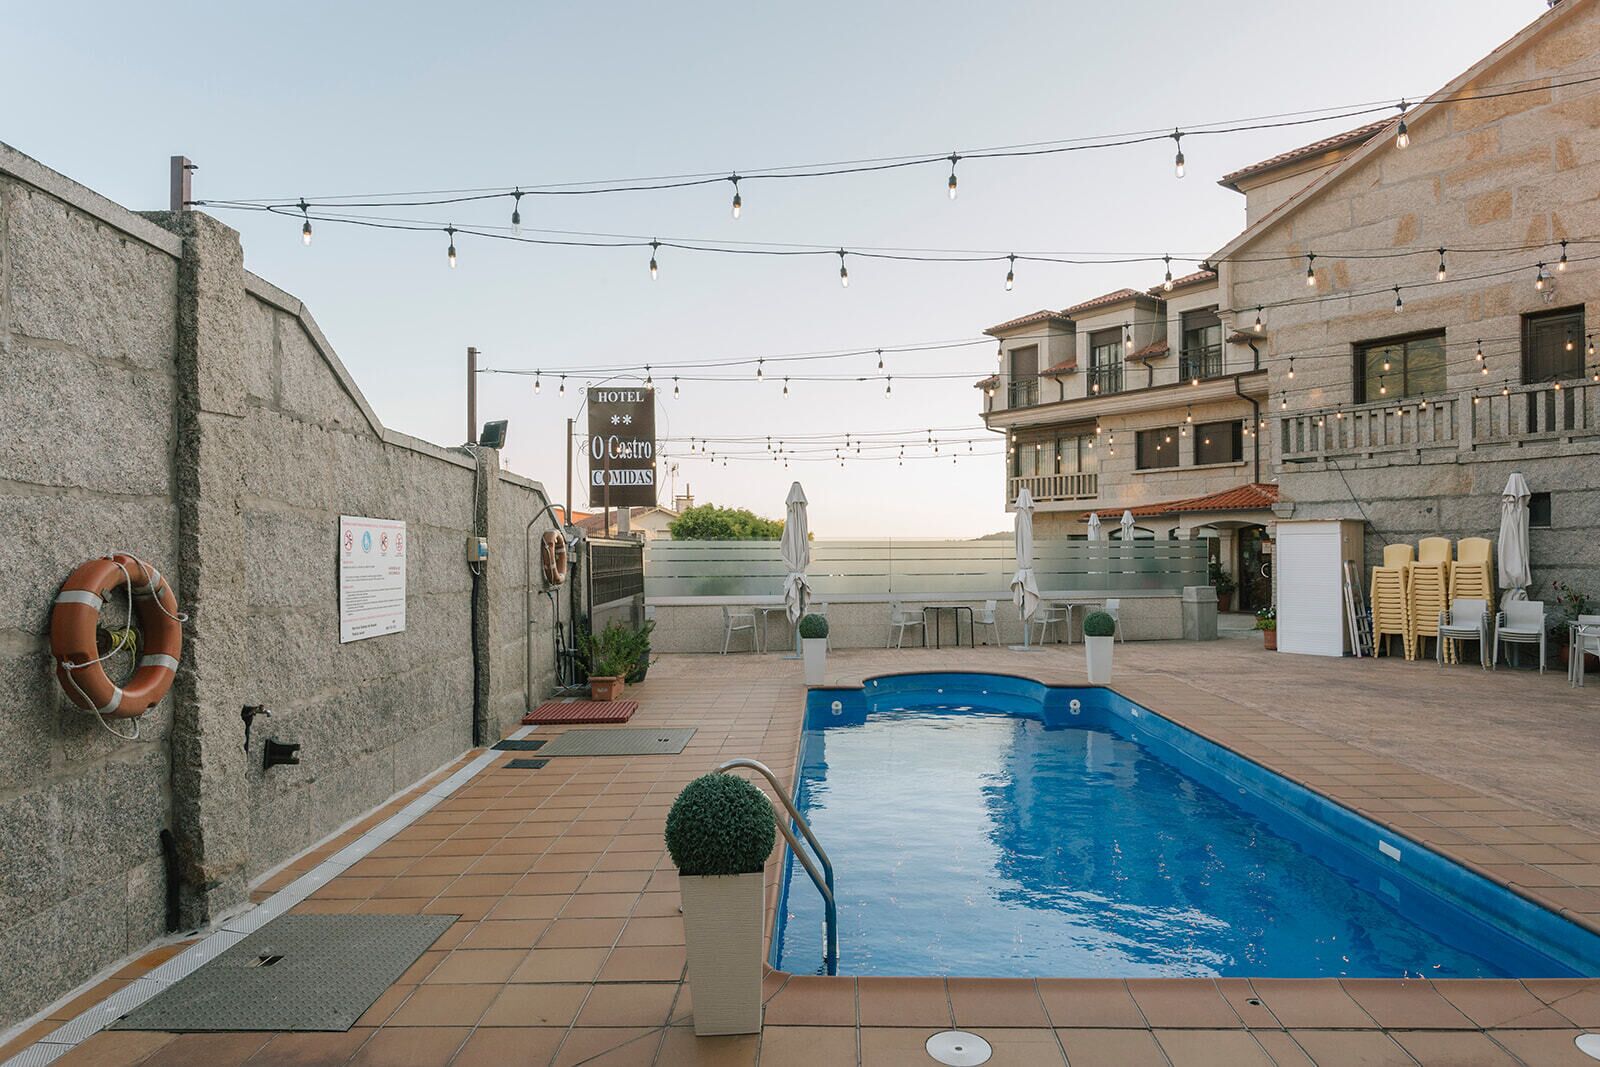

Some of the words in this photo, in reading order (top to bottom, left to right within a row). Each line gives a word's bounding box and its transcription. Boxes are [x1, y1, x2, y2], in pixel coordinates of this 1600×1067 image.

[598, 391, 644, 402] HOTEL
[592, 435, 604, 460] O
[608, 435, 652, 460] Castro
[593, 470, 652, 485] COMIDAS
